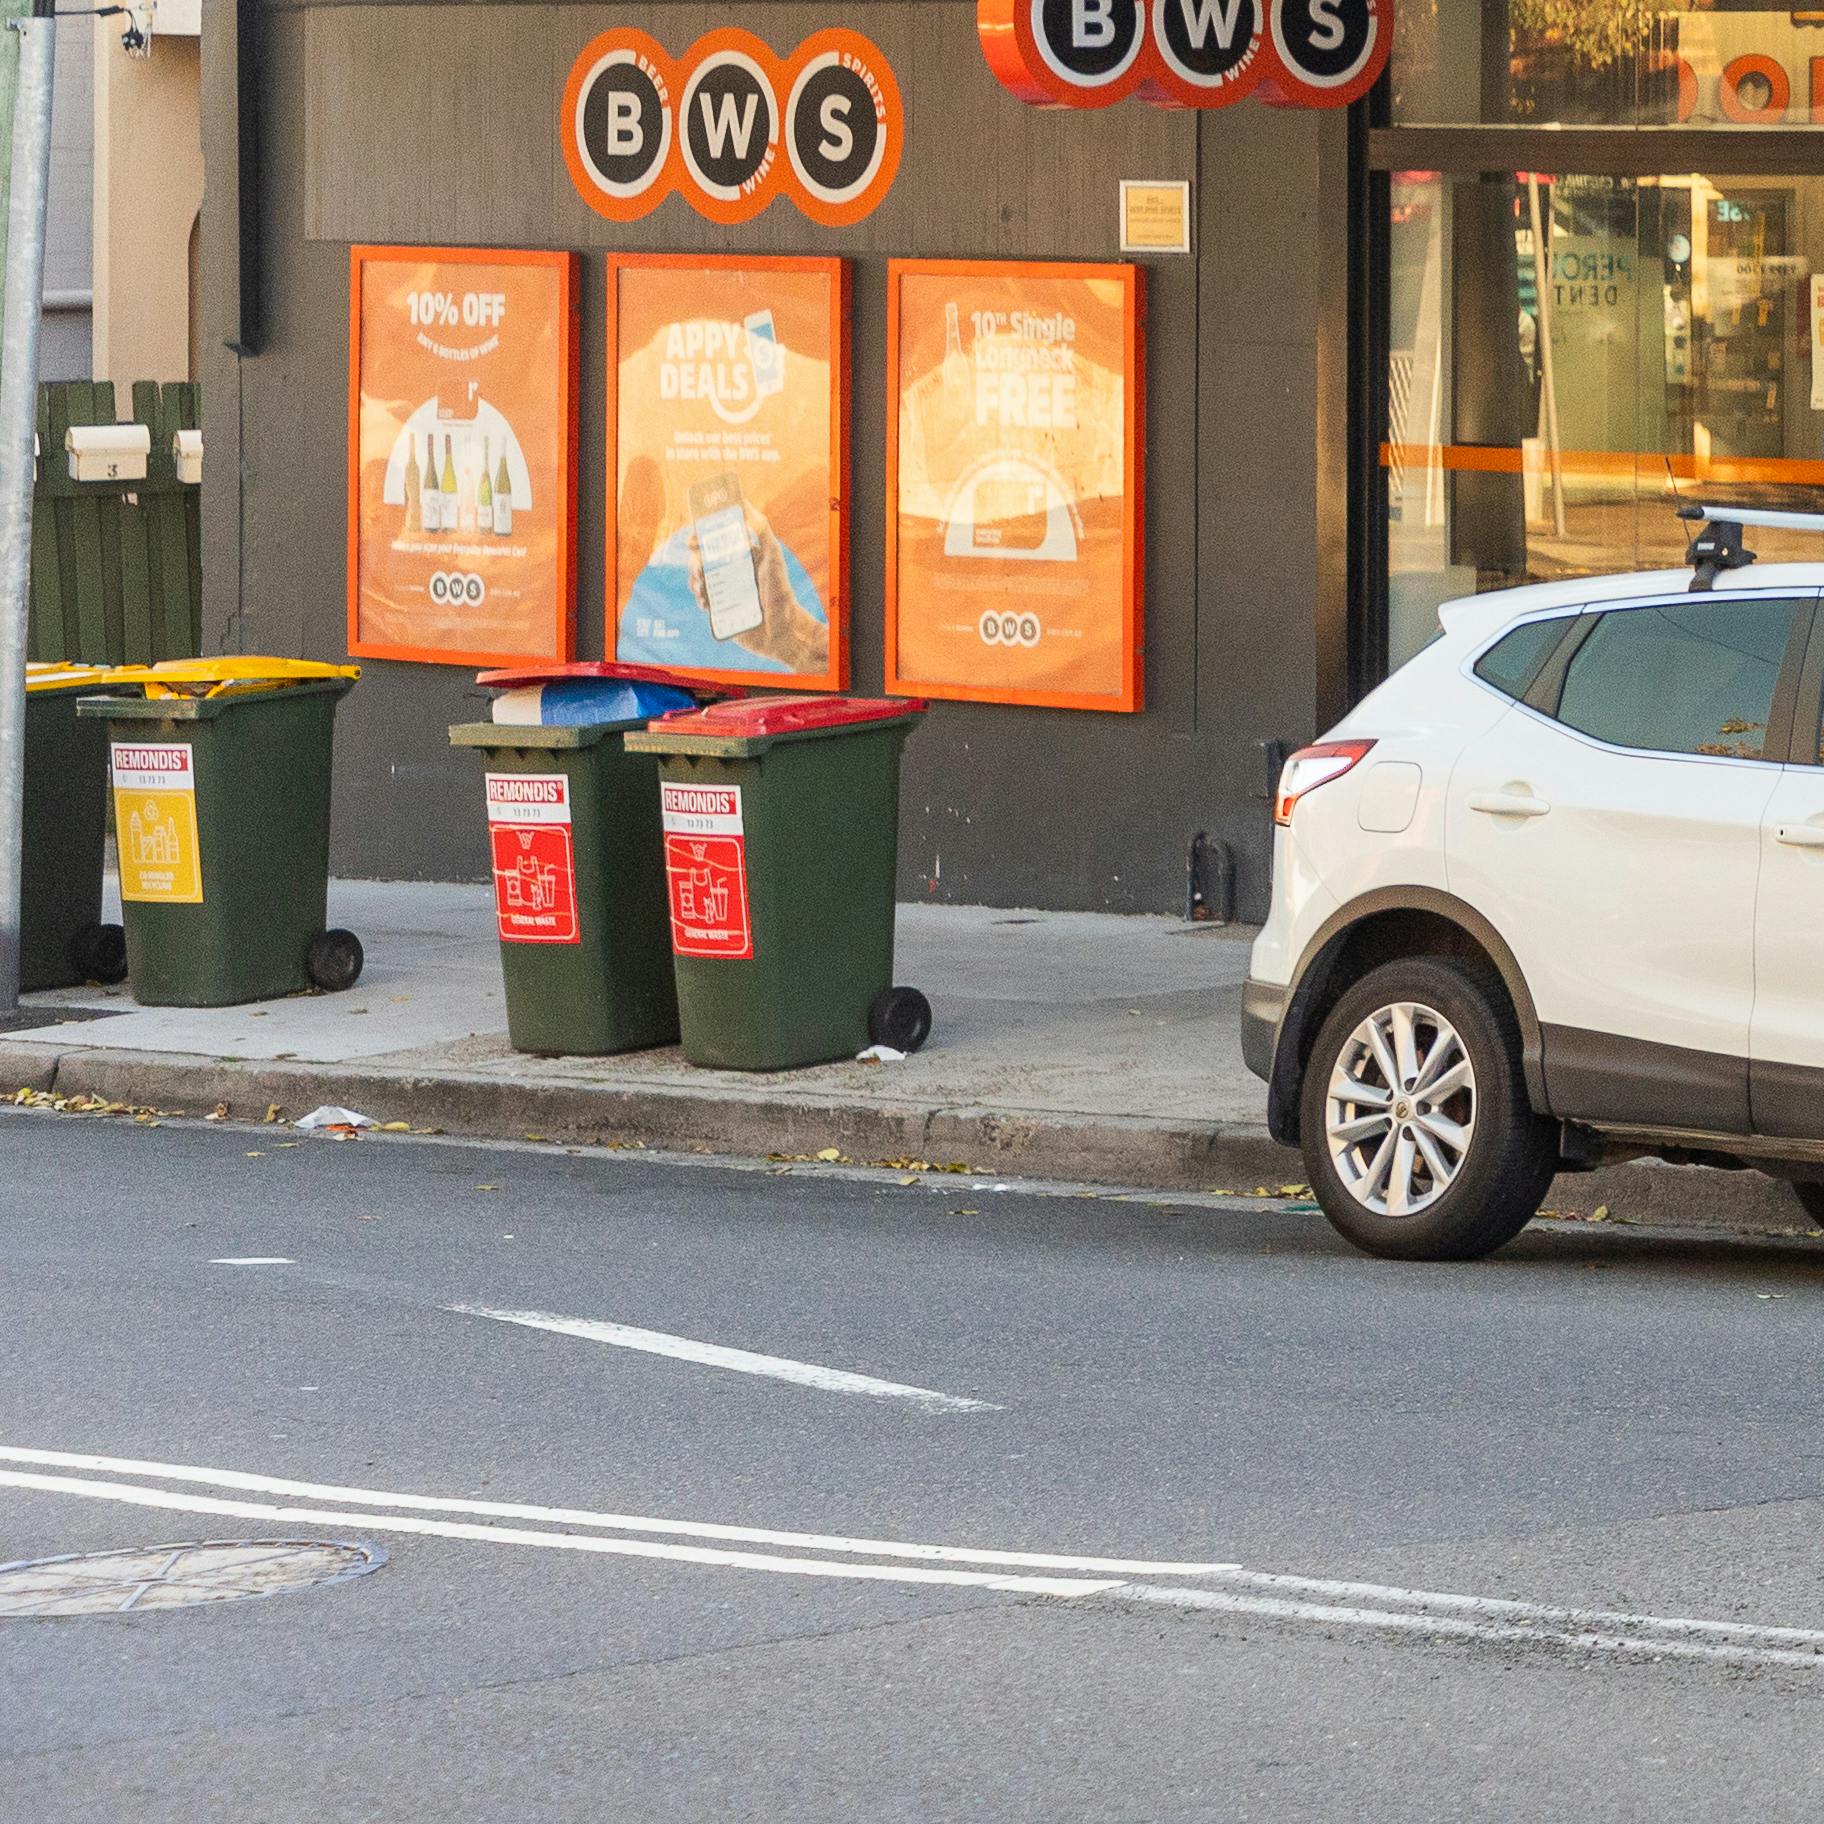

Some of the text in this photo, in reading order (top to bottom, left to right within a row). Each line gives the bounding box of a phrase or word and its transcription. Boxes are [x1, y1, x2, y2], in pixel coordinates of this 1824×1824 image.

[634, 54, 670, 105] BEER
[1223, 38, 1262, 83] WINE
[842, 52, 887, 120] SPIRITS
[741, 147, 776, 196] WINE
[406, 291, 506, 327] 10% OFF
[665, 322, 741, 360] APPY
[659, 363, 749, 401] DEALS
[975, 373, 1077, 427] FREE
